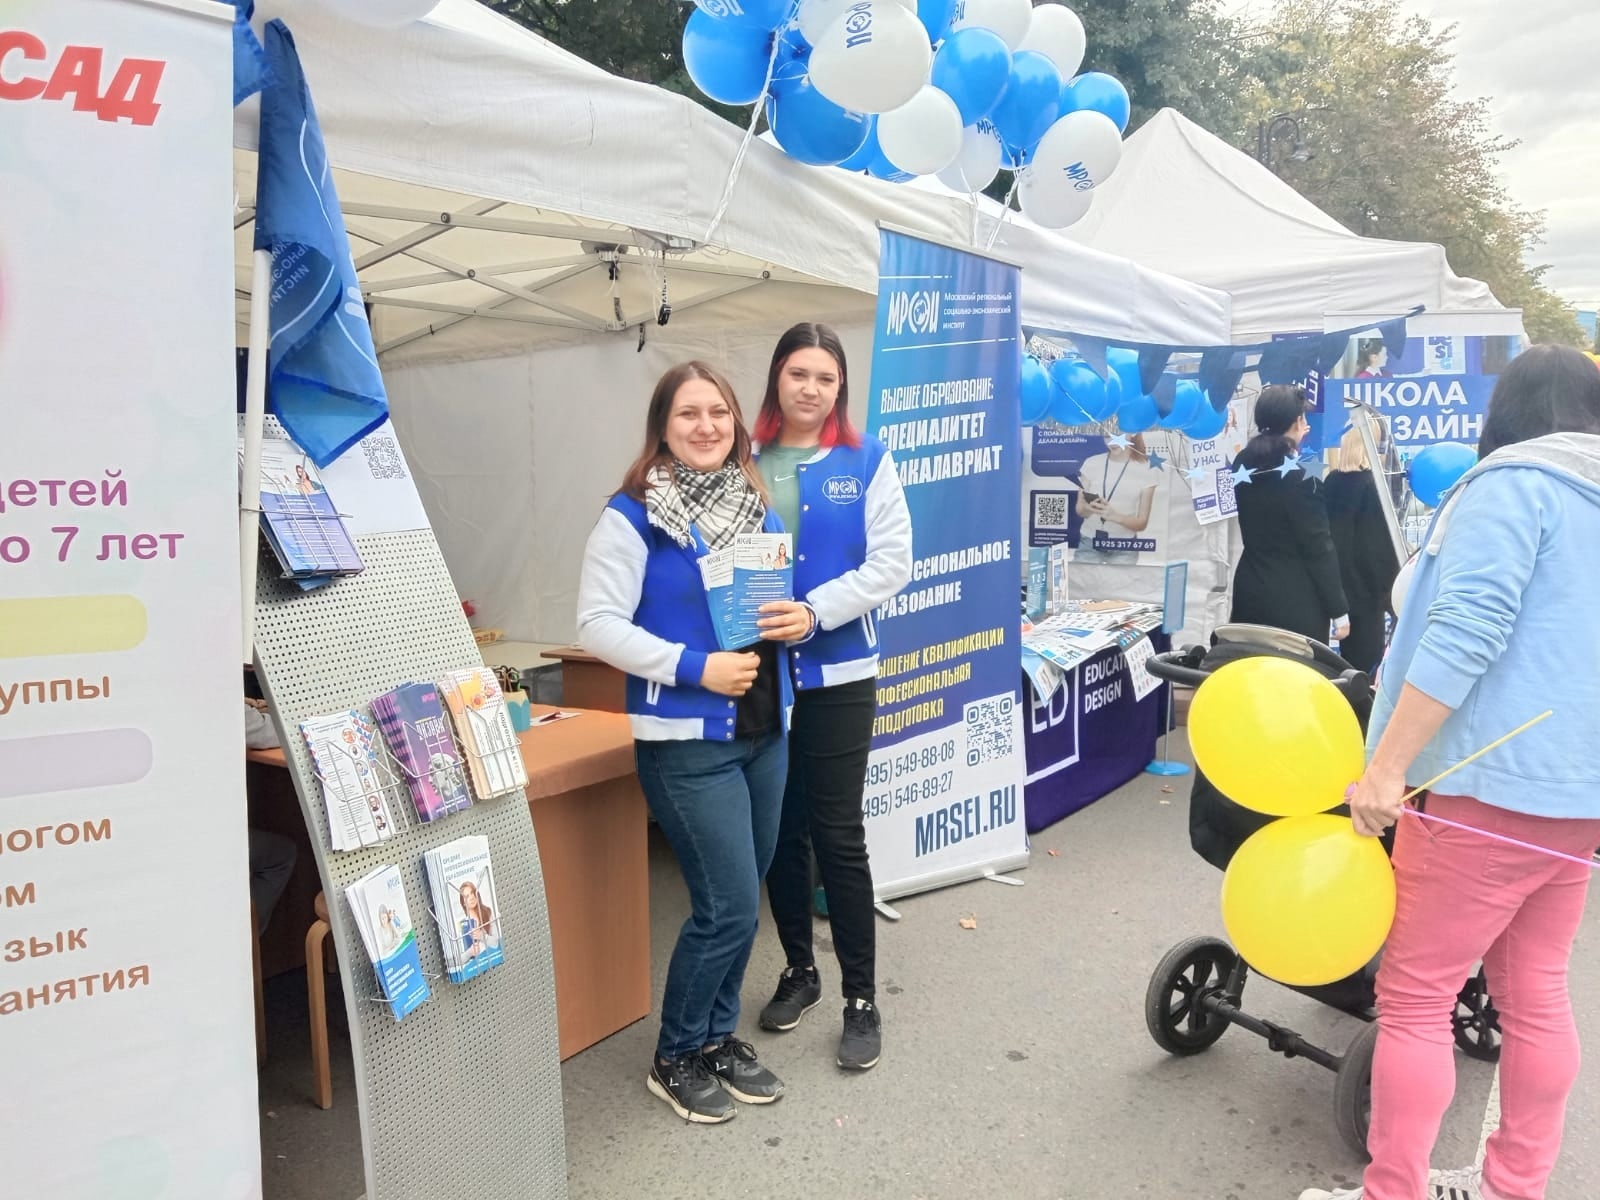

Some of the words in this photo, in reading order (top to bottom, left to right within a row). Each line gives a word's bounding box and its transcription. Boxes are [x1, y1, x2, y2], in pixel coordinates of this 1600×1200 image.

[0, 31, 166, 126] САД
[880, 385, 921, 415] ВЫСШЕЕ
[1343, 381, 1468, 408] ШКОЛА
[878, 412, 986, 451] СПЕЦИАЛИТЕТ
[1384, 408, 1483, 441] ЗАЙН
[894, 445, 1003, 487] АКАЛАВРИАТ
[1201, 454, 1221, 466] НАС
[0, 469, 128, 513] етей
[51, 526, 79, 562] 7
[96, 533, 185, 561] лет
[912, 540, 1011, 582] ССИОНАЛЬНОЕ
[1101, 540, 1115, 548] 925
[877, 580, 962, 621] РАЗОВАНИЕ
[922, 627, 1004, 667] КВАЛИФИКАЦИИ
[1085, 679, 1122, 714] DESIGN
[895, 739, 955, 778] 549-88-08
[895, 770, 953, 809] 546-89-27
[0, 819, 112, 855] огом
[915, 784, 1016, 858] MRSEI.RU
